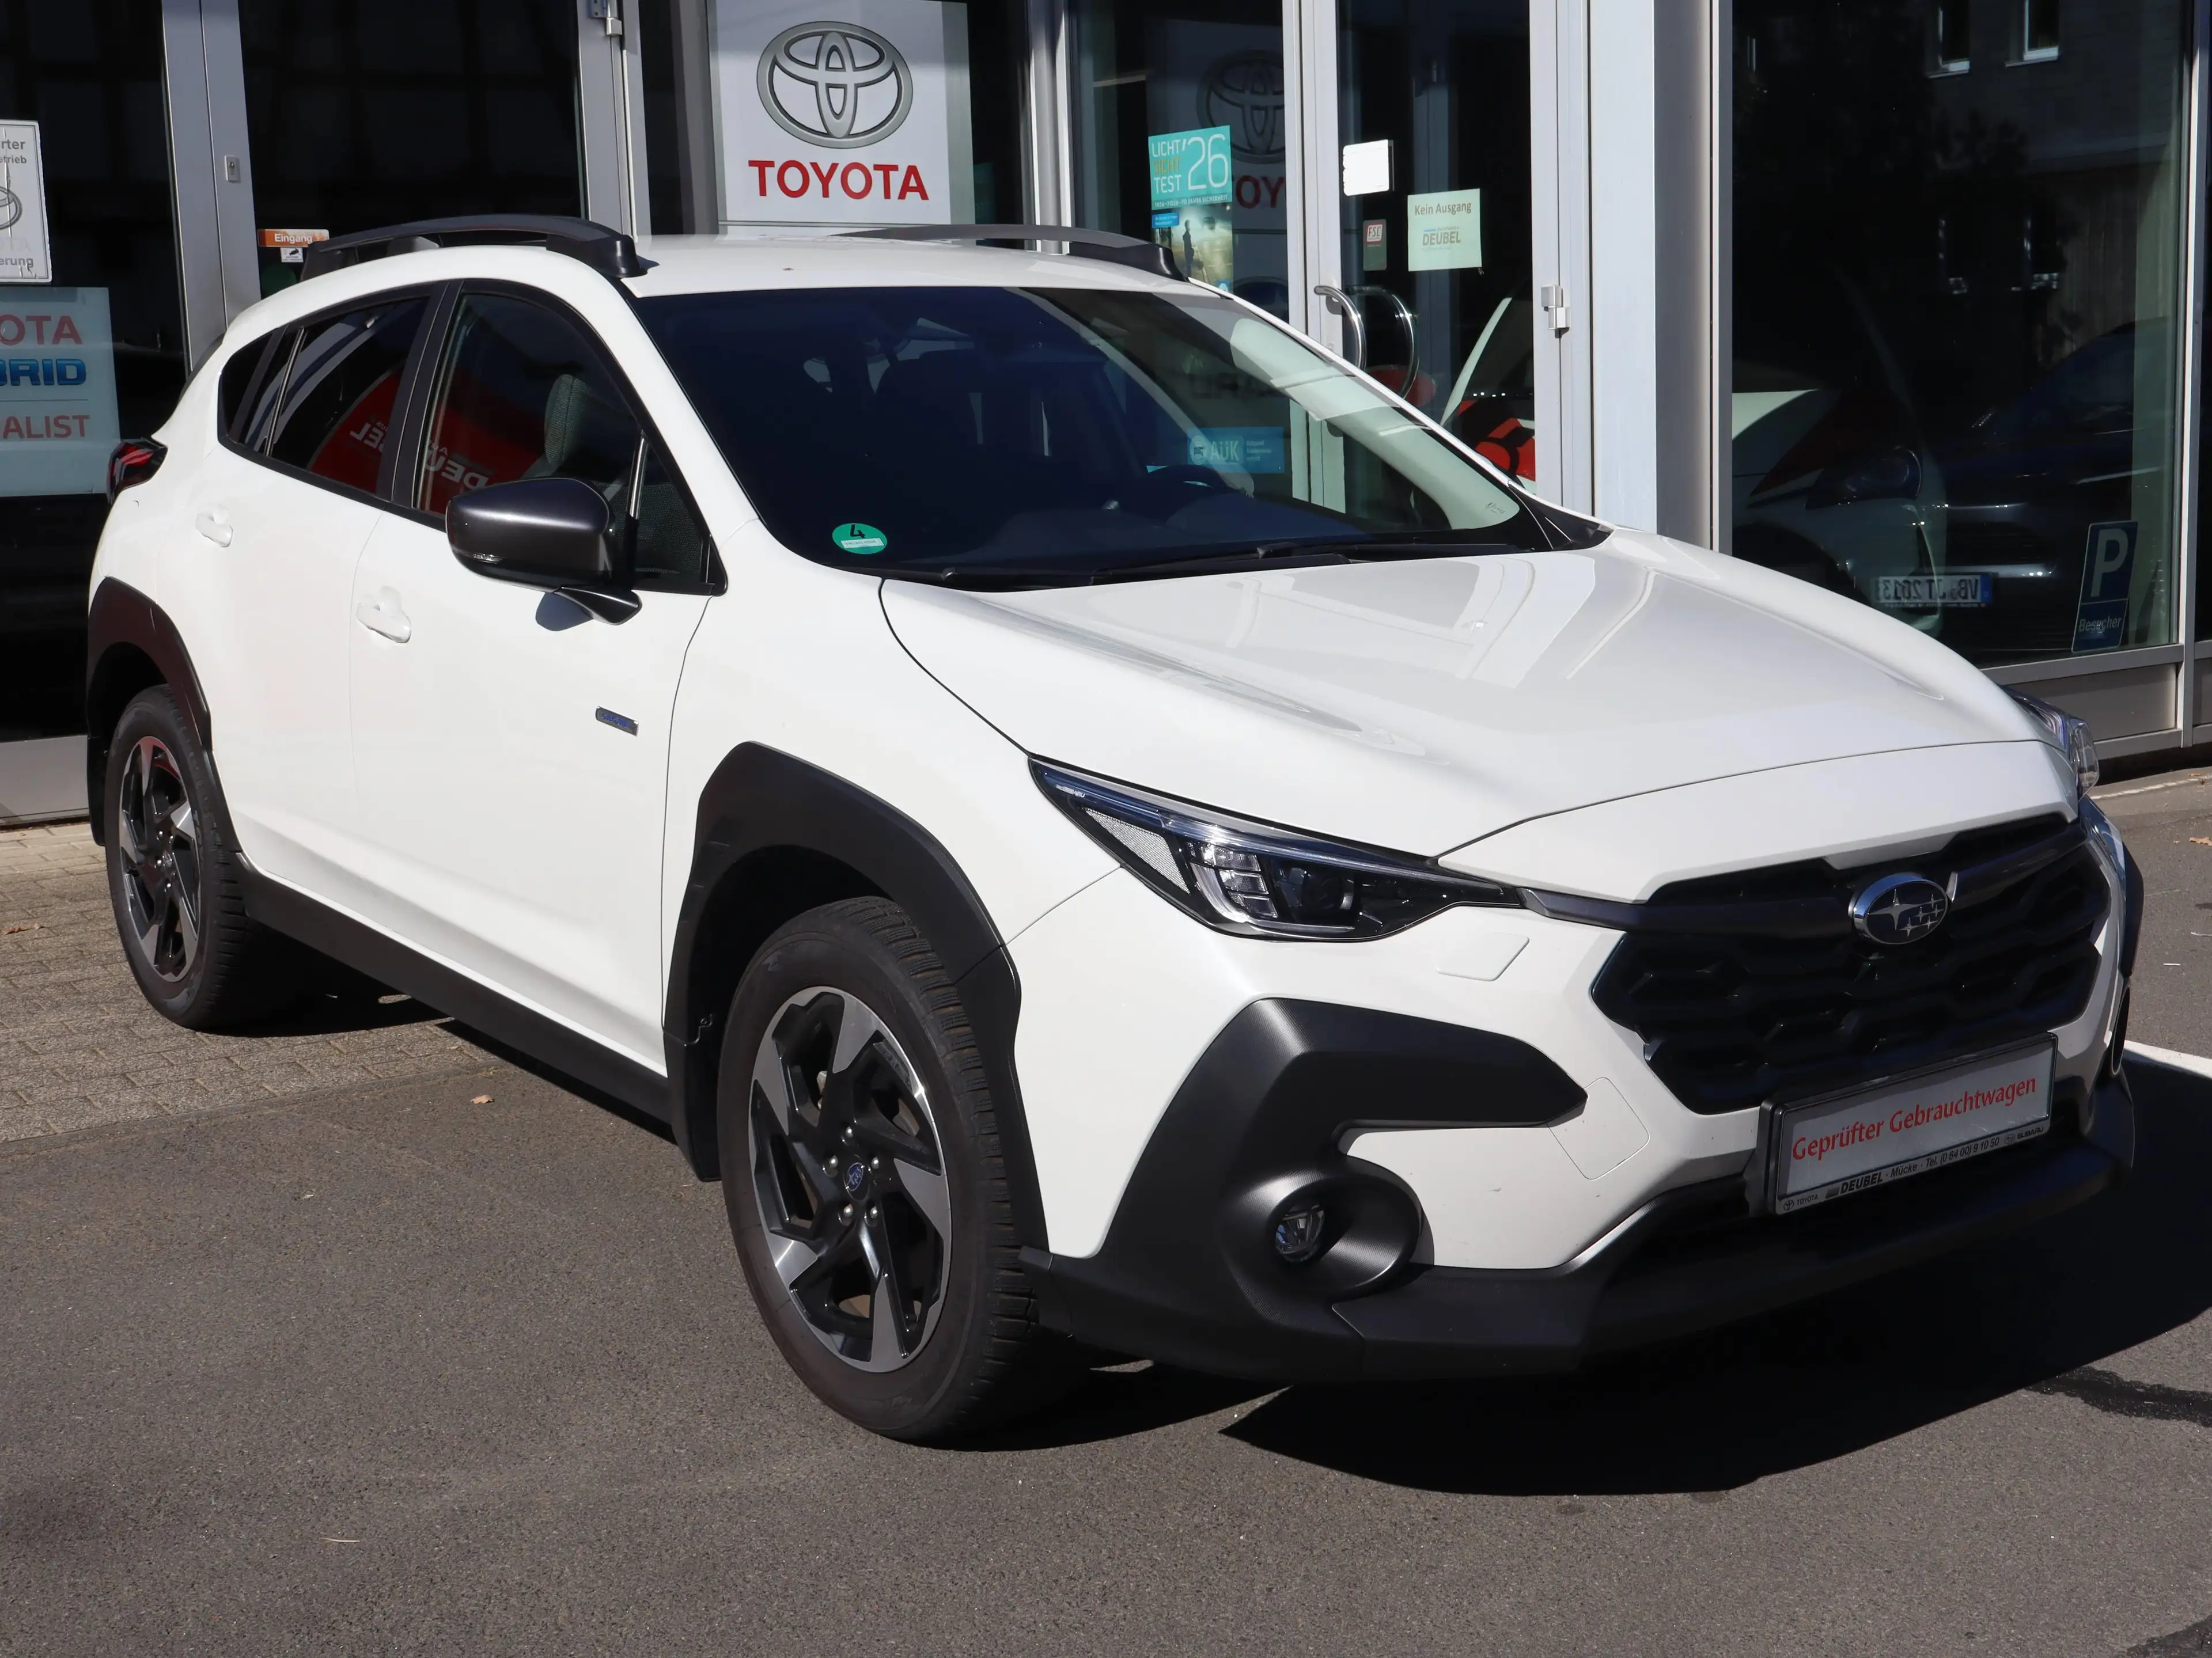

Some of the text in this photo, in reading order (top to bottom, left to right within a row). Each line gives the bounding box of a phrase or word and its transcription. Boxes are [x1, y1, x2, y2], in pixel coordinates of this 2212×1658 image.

[1152, 139, 1180, 158] LICHT
[748, 160, 930, 201] TOYOTA
[1153, 174, 1182, 194] TEST
[1415, 202, 1472, 215] Kein Ausgang
[274, 233, 312, 245] Eingang
[1422, 231, 1461, 246] DEUBEL
[0, 358, 86, 386] RID
[3, 415, 90, 439] ALIST
[2090, 528, 2129, 598] P
[2078, 615, 2122, 632] Besucher
[1793, 1077, 2036, 1161] Geprüfter Gebrauchtwagen
[2017, 1126, 2044, 1140] SUBARU
[1840, 1173, 1884, 1194] DEUBEL
[1890, 1163, 1918, 1178] Mücke
[1926, 1156, 1938, 1168] Tel.
[1797, 1194, 1819, 1206] TOYOTA
